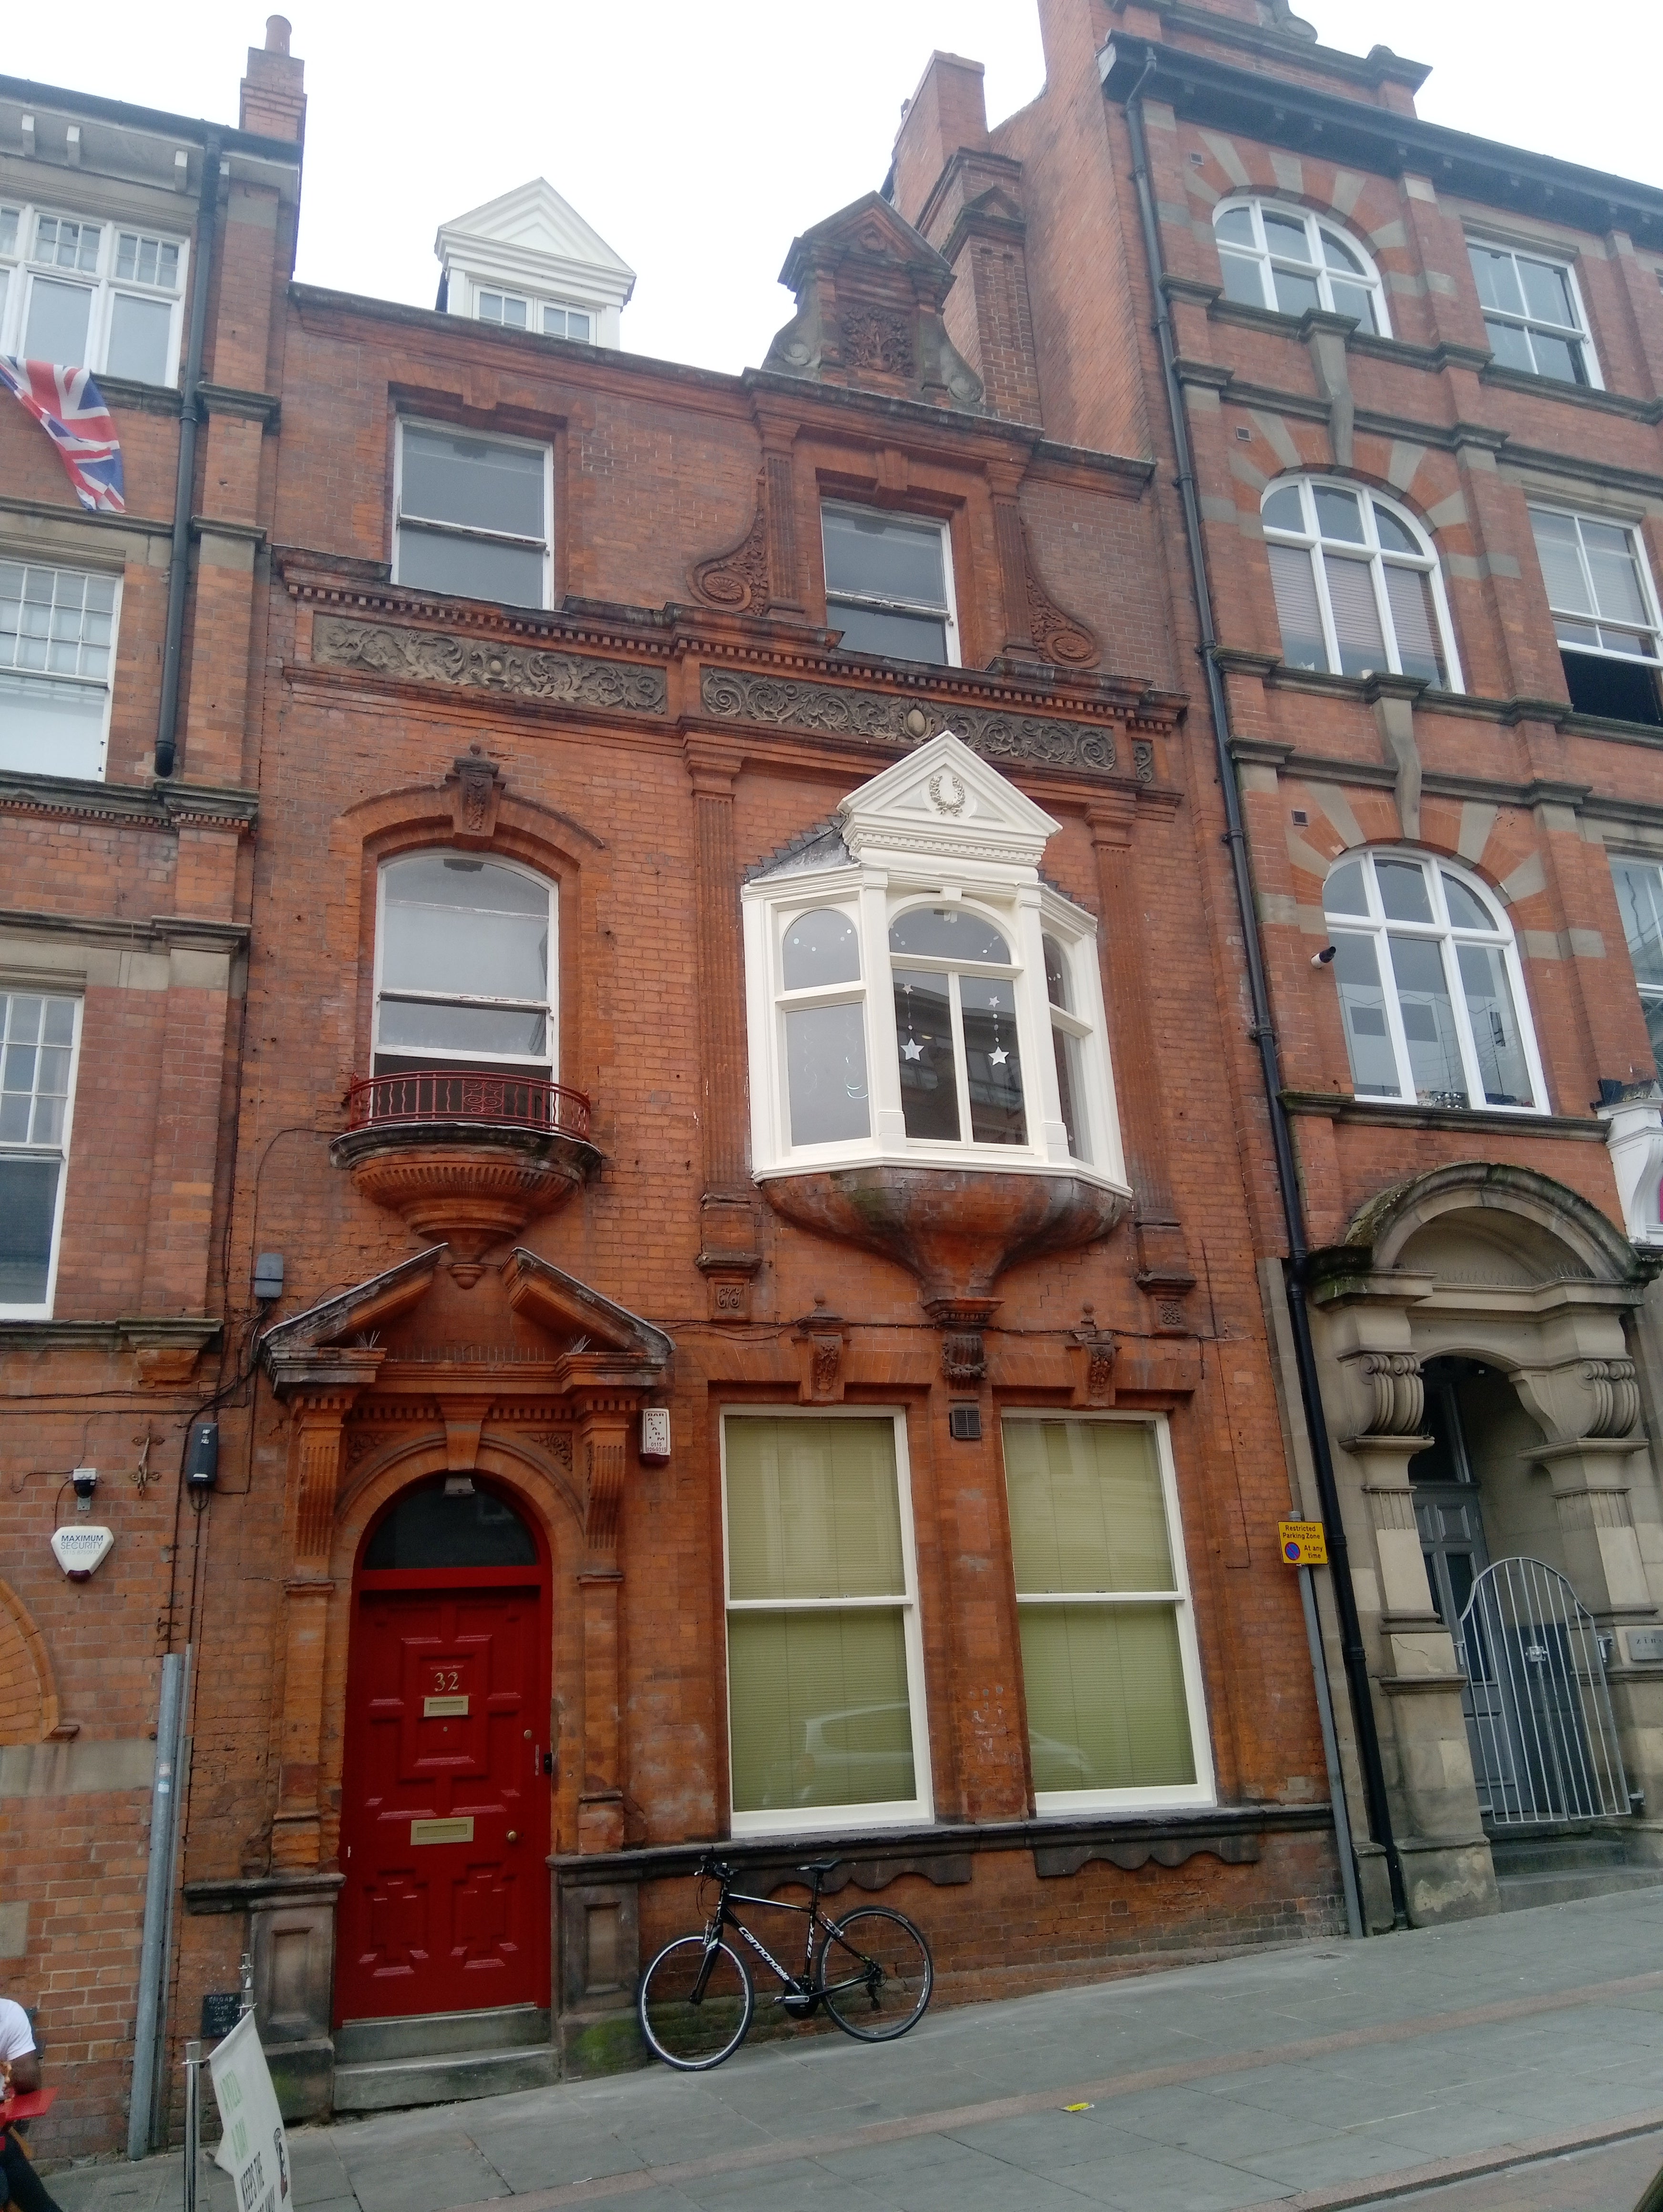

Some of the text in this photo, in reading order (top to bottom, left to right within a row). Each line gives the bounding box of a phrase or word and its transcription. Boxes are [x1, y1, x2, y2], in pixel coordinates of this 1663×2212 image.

[647, 1418, 665, 1441] ALARM
[61, 1541, 103, 1549] SECURITY
[434, 1672, 459, 1692] 32
[738, 1926, 790, 1981] Cannondale
